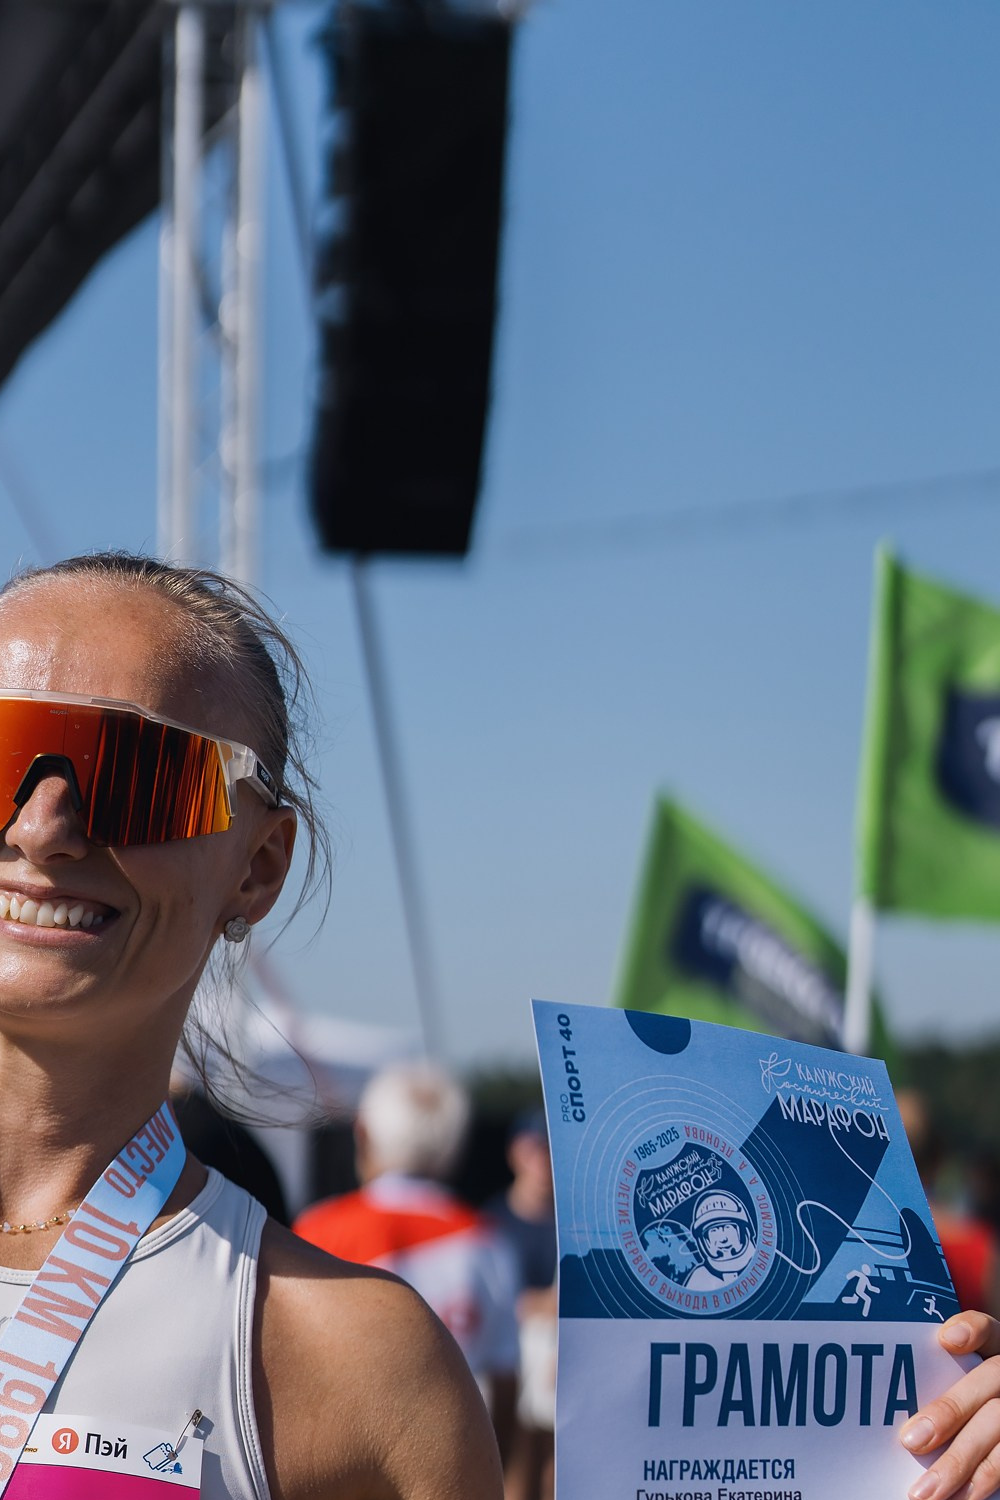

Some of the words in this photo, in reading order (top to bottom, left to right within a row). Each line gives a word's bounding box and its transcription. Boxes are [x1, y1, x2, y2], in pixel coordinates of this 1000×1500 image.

[557, 1013, 573, 1042] 40
[562, 1045, 586, 1123] СПОРТ
[795, 1062, 876, 1097] КАЛУЖСКИЙ
[560, 1093, 571, 1123] PRO
[776, 1091, 891, 1141] МАРАФОН
[633, 1126, 680, 1161] 1965-2025
[684, 1125, 734, 1158] ЛЕОНОВА
[655, 1150, 701, 1184] КАЛУЖСКИЙ
[617, 1159, 637, 1226] 60-ЛЕТИЕ
[648, 1169, 713, 1217] МАРАФОН
[63, 1202, 141, 1261] 10
[756, 1193, 774, 1247] КОСМОС
[621, 1231, 658, 1287] ПЕРВОГО
[723, 1249, 772, 1305] ОТКРЫТЫЙ
[14, 1255, 111, 1343] КМ
[658, 1284, 708, 1310] ВЫХОДА
[713, 1295, 720, 1308] В
[648, 1342, 919, 1427] ГРАМОТА
[85, 1432, 128, 1459] Пэй
[643, 1459, 795, 1484] НАГРАЖДАЕТСЯ
